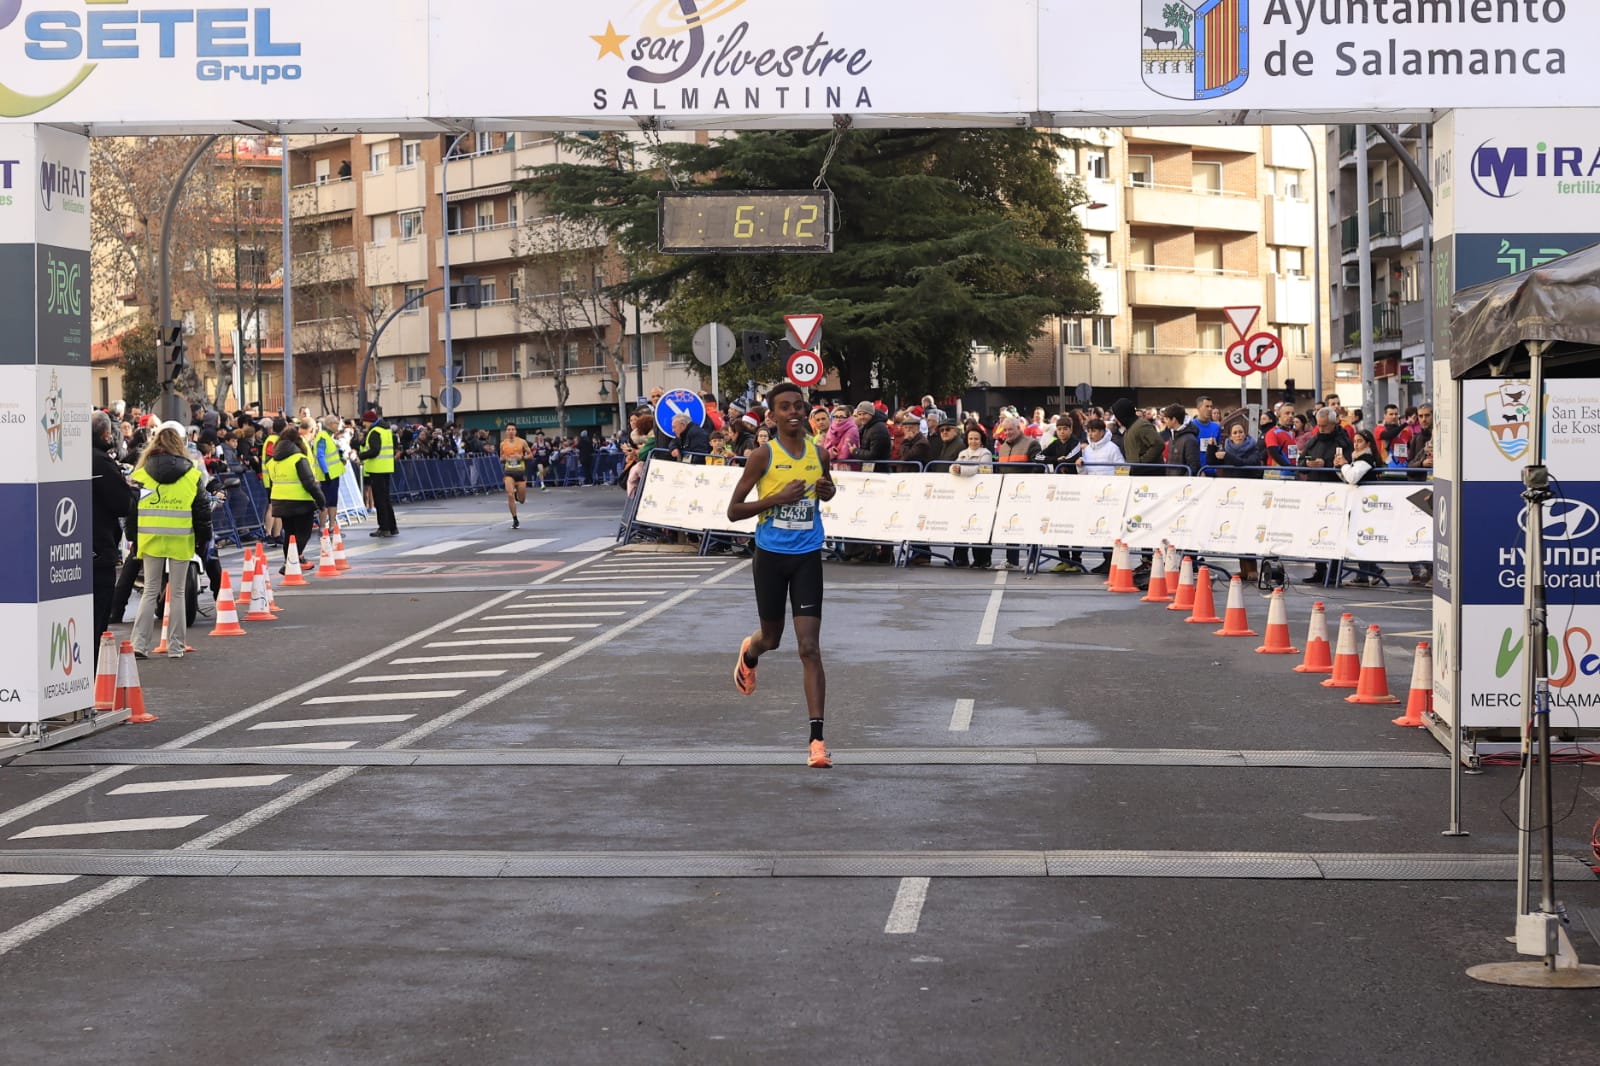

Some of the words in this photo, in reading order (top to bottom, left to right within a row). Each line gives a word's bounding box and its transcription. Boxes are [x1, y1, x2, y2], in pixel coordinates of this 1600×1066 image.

[1263, 0, 1566, 35] Ayuntamiento
[24, 8, 302, 60] SETEL
[631, 37, 684, 62] san
[1264, 40, 1314, 76] de
[1336, 39, 1566, 76] Salamanca
[196, 60, 302, 84] Grupo
[593, 87, 873, 110] SALMANTINA
[1233, 353, 1242, 364] 3
[795, 363, 815, 375] 30
[0, 411, 26, 424] slao
[1552, 406, 1576, 420] San
[1552, 421, 1568, 434] de
[780, 506, 807, 520] 5433
[50, 542, 82, 563] HYUNDAI
[1498, 568, 1600, 588] Getoraut
[1471, 693, 1600, 708] MERCALAMA
